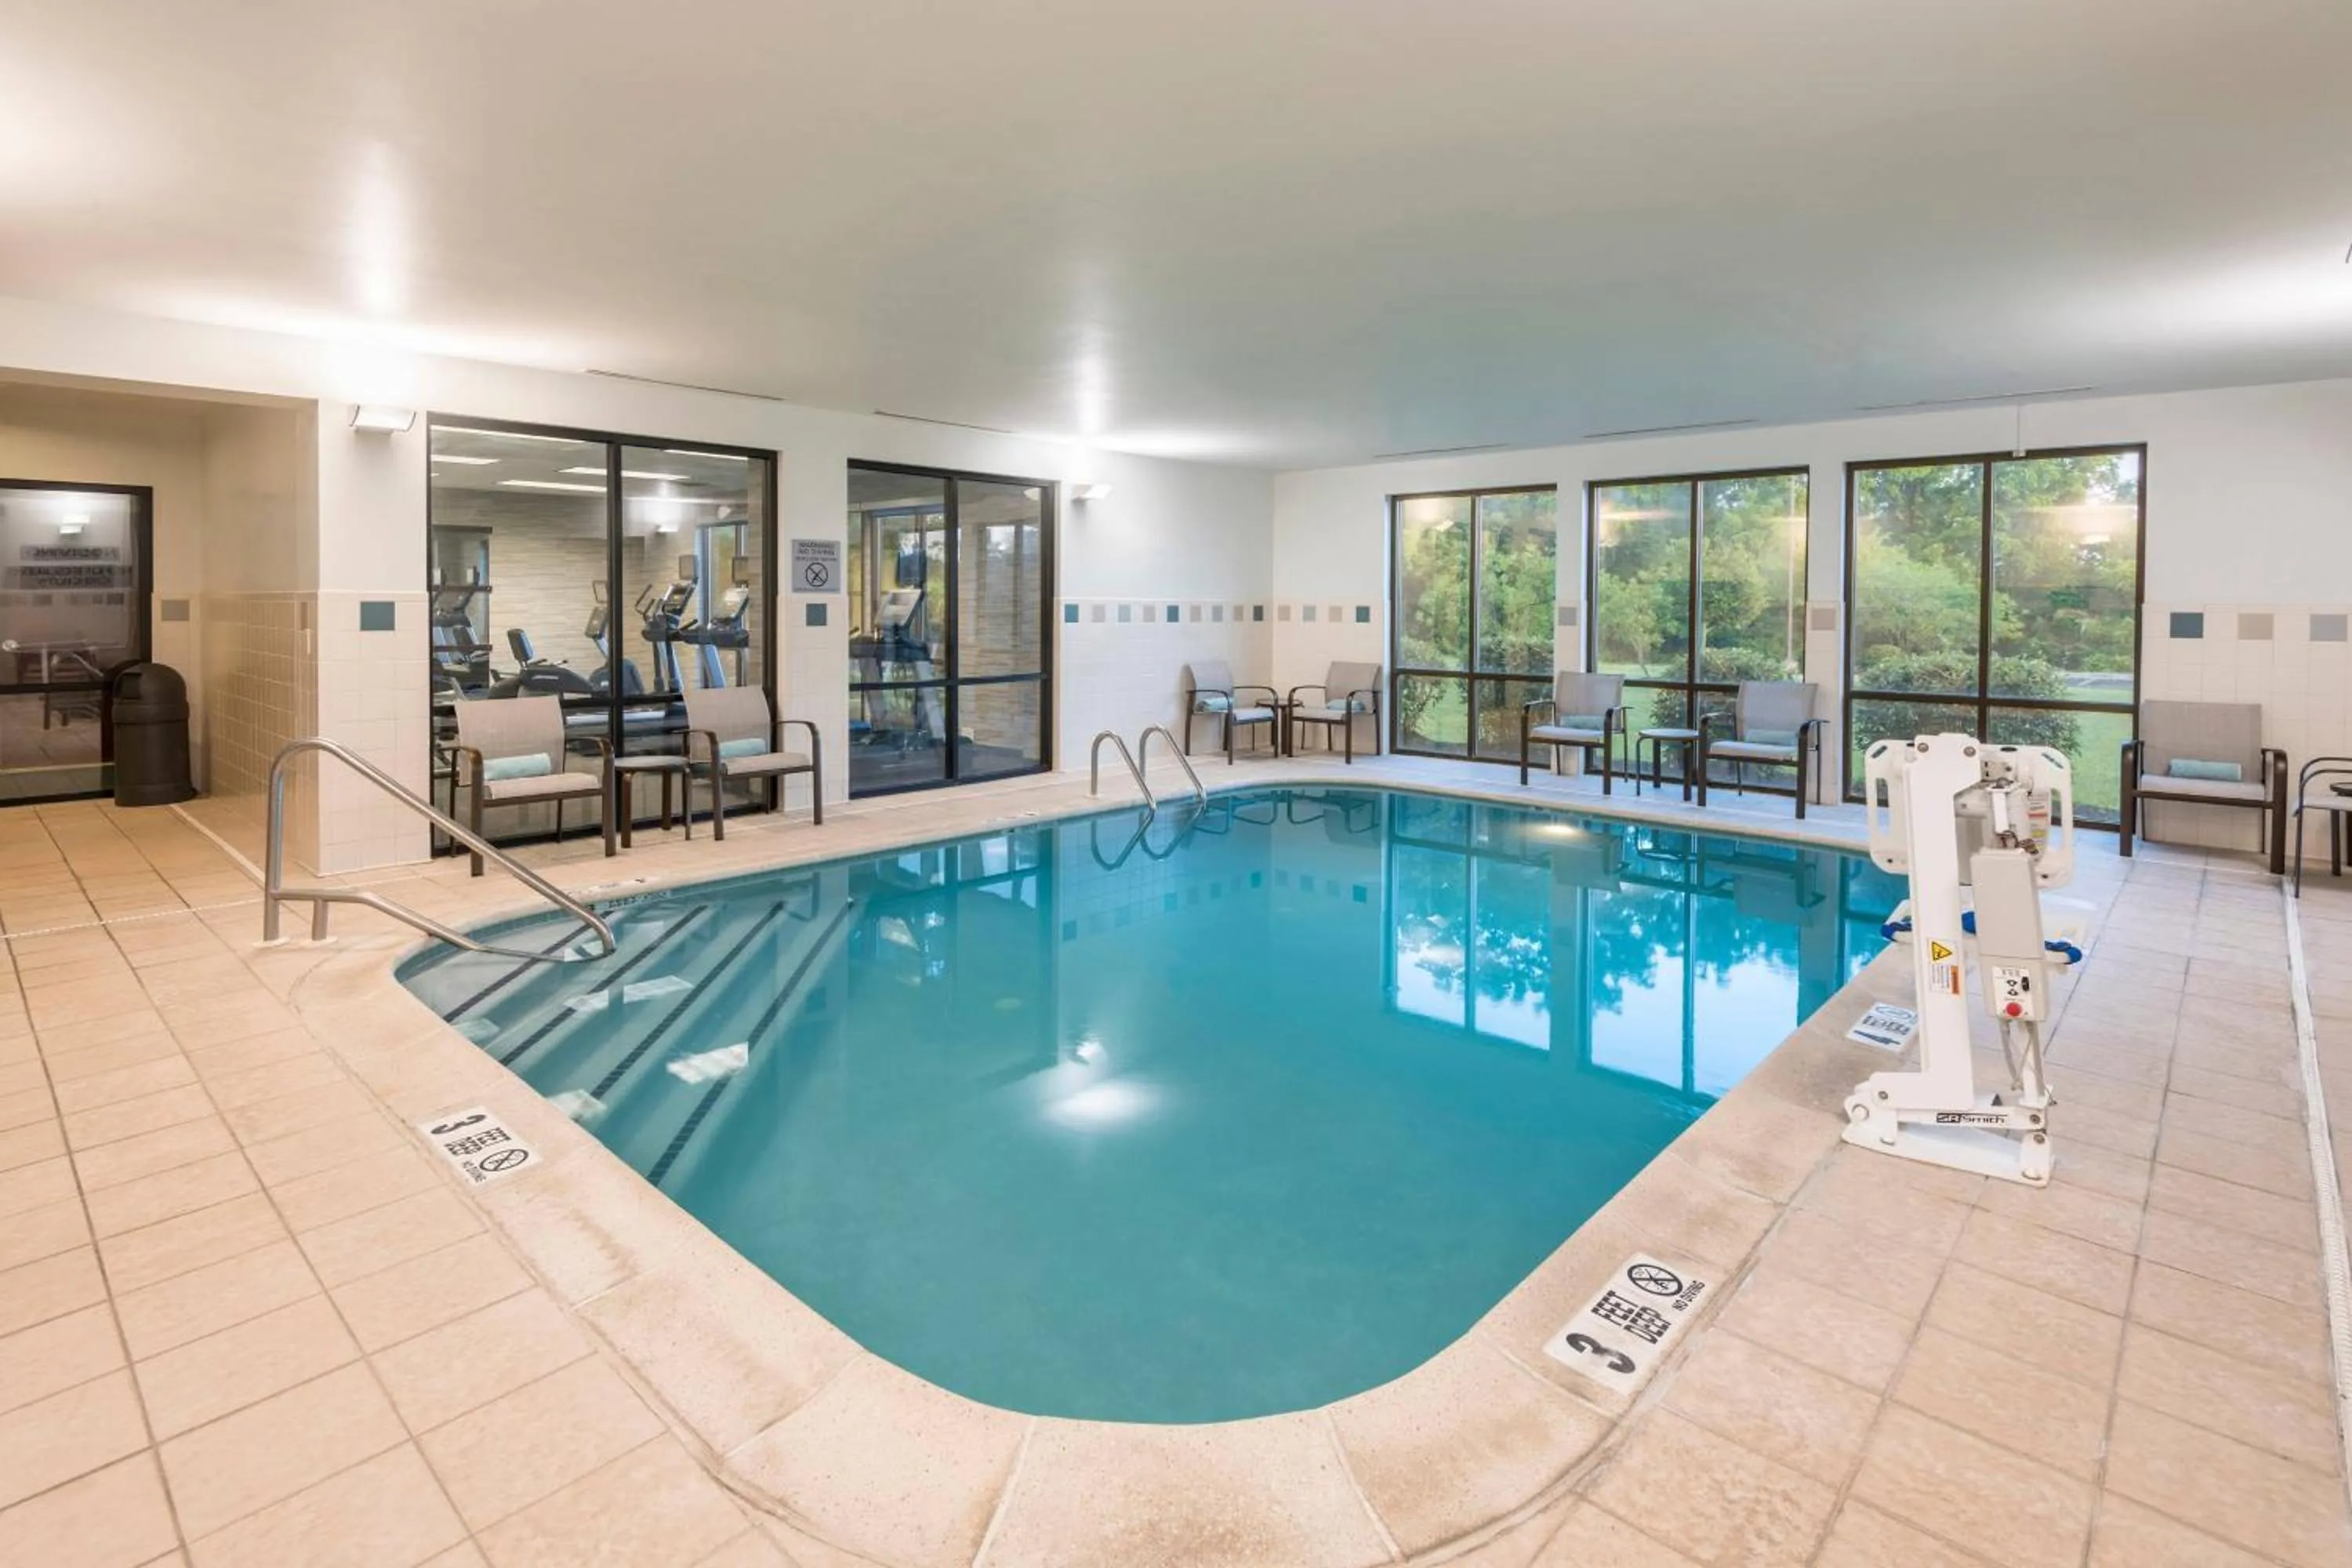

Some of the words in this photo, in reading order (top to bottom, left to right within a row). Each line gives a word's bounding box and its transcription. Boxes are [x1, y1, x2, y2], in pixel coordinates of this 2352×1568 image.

[430, 1114, 487, 1134] 3
[474, 1127, 512, 1147] FEET
[1591, 1290, 1639, 1327] FEET
[1623, 1306, 1672, 1345] DEEP
[1566, 1333, 1636, 1374] 3
